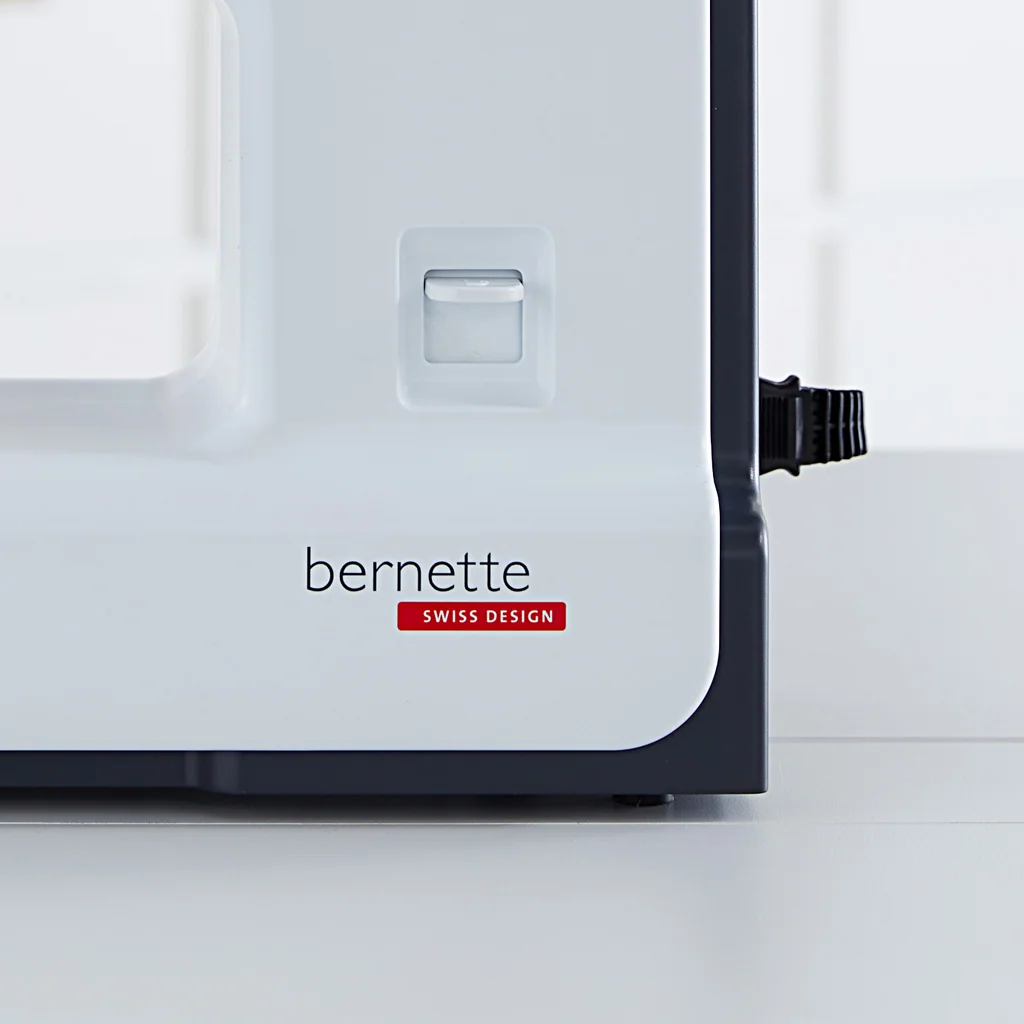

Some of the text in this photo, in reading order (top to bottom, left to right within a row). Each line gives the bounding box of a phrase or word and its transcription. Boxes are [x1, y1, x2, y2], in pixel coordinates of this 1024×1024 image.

[305, 546, 531, 592] bernette
[422, 609, 554, 624] SWISS DESIGN
